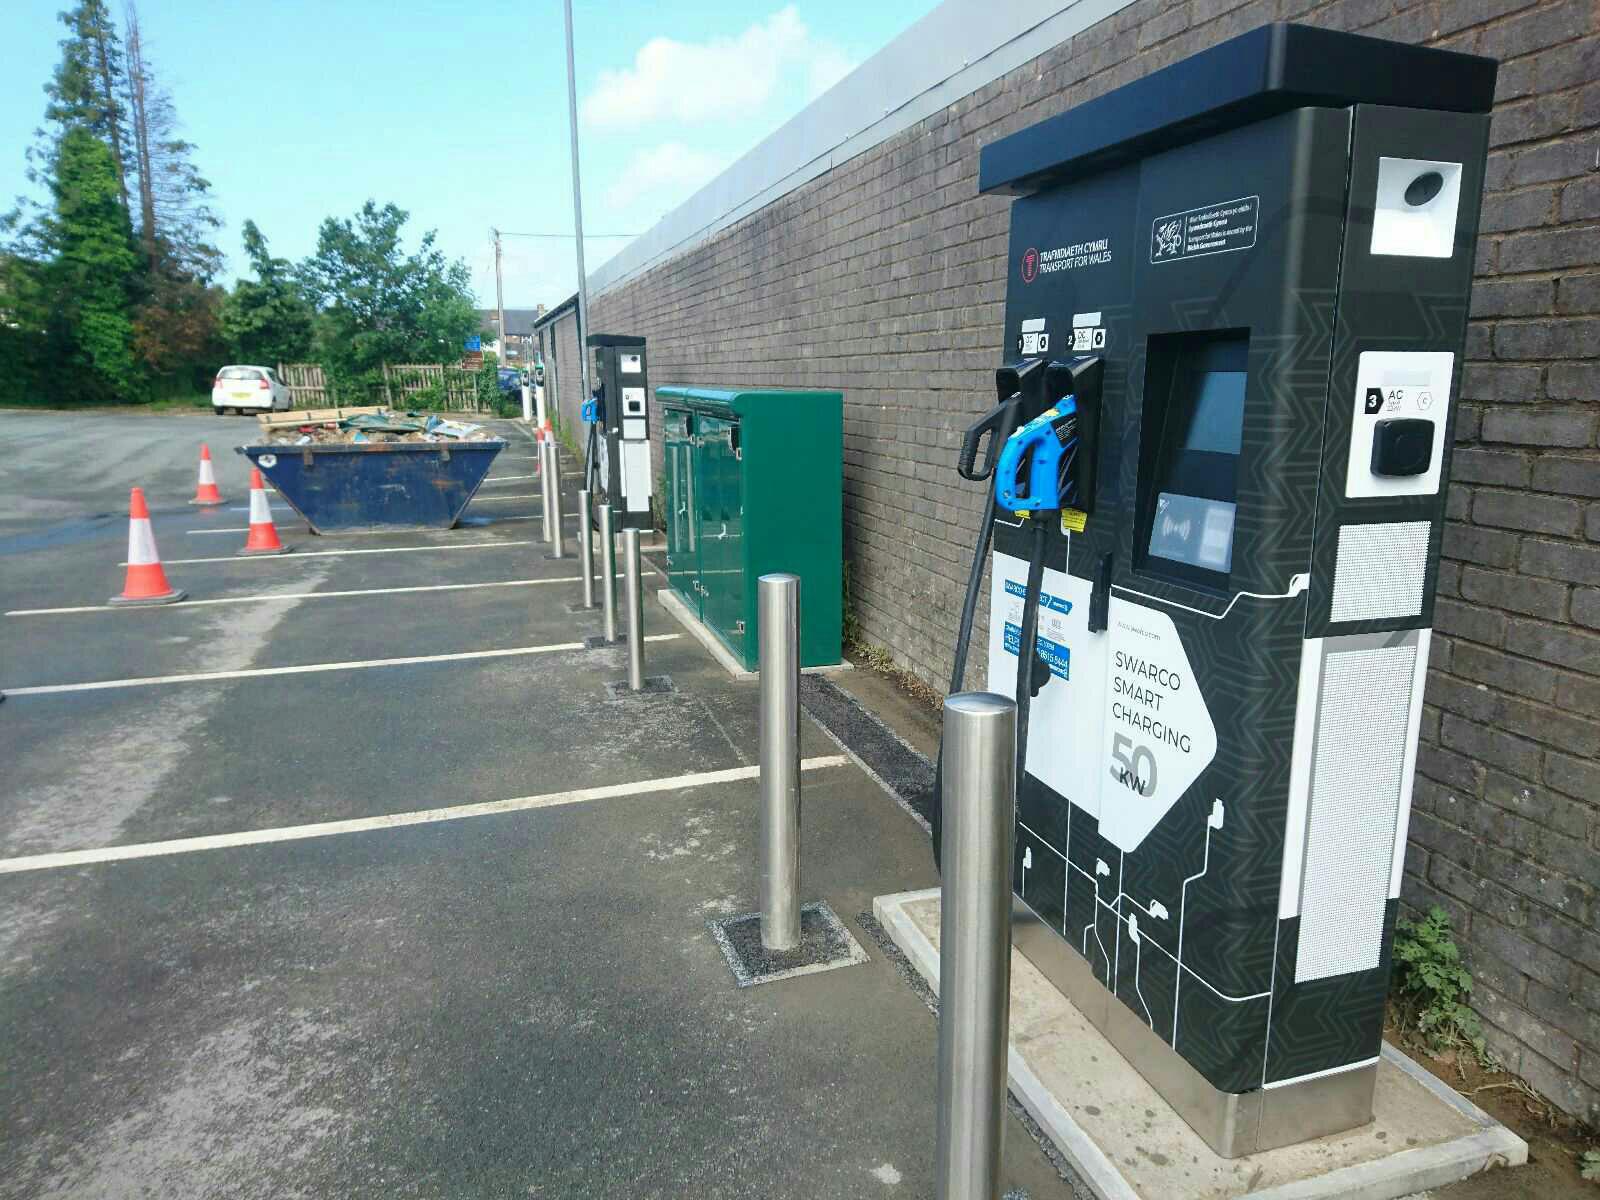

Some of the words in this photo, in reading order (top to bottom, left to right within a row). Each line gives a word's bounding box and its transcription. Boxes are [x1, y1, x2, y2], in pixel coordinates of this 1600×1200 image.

[1083, 238, 1109, 253] CYMRU
[1040, 257, 1075, 273] TRANSPORT
[1074, 255, 1088, 268] FOR
[1088, 250, 1112, 265] WALES
[1368, 394, 1377, 408] 3
[1388, 390, 1404, 400] AC
[1115, 650, 1181, 690] SWARCO
[1113, 676, 1164, 711] SMART
[1112, 702, 1191, 753] CHARGING
[1110, 732, 1158, 797] 50
[1119, 766, 1146, 795] KW
